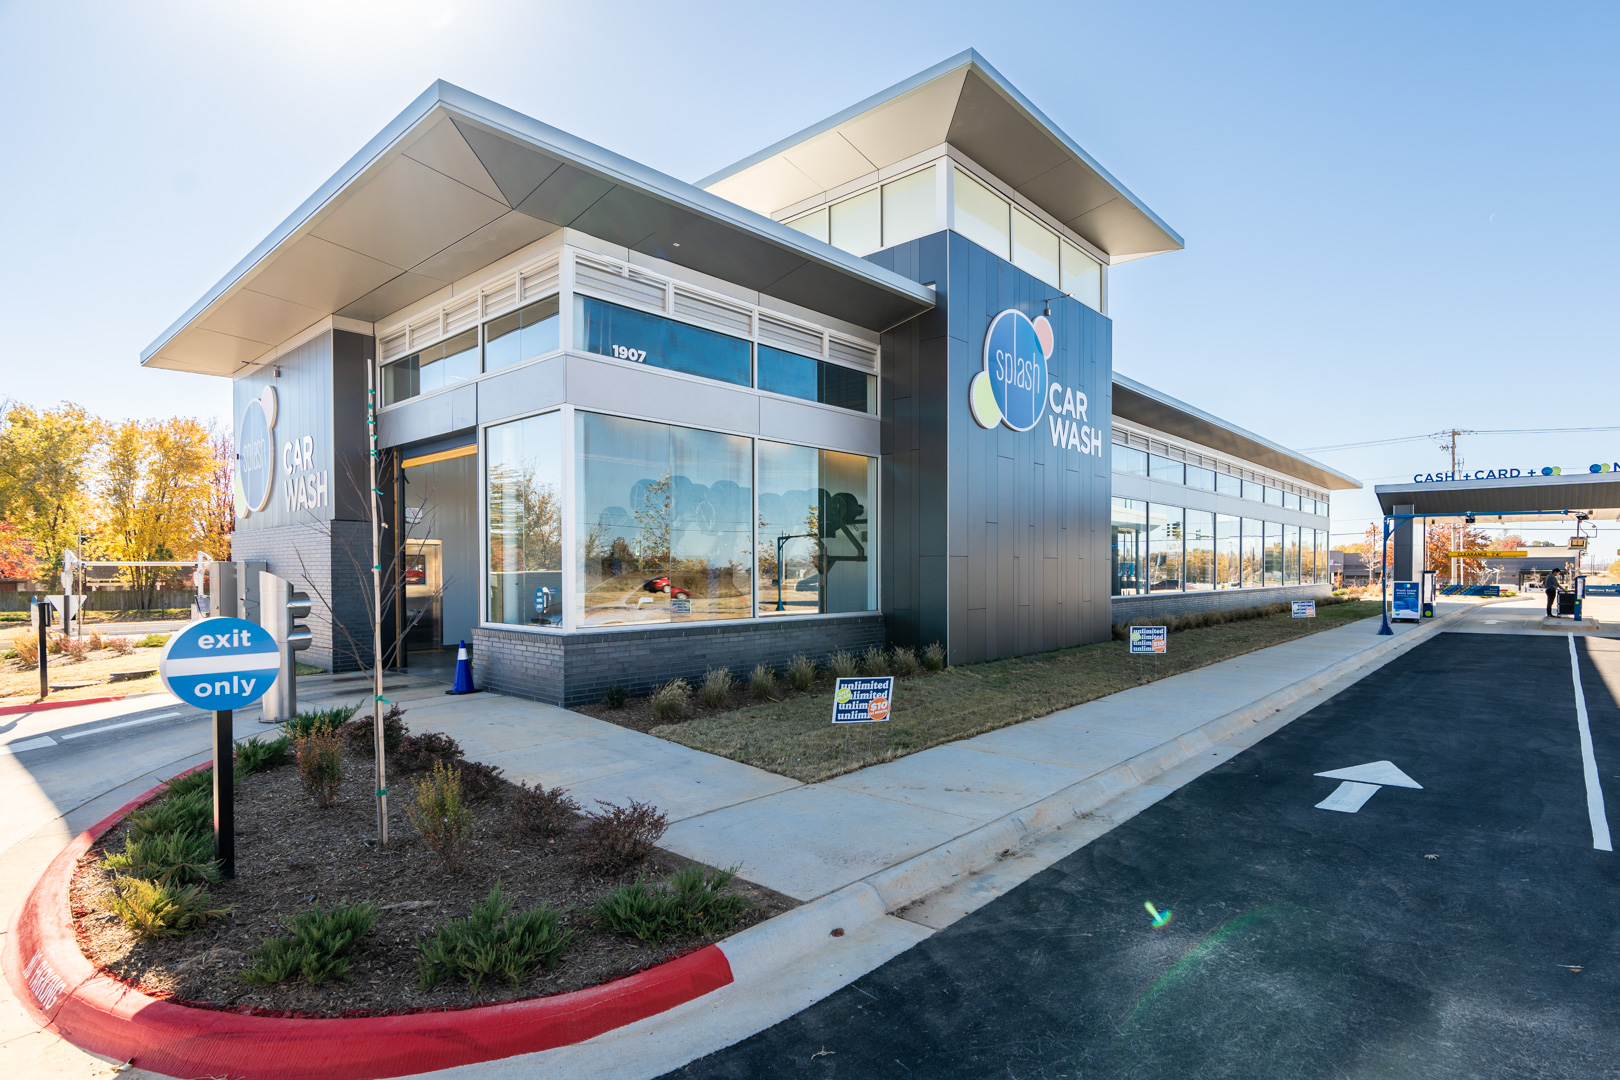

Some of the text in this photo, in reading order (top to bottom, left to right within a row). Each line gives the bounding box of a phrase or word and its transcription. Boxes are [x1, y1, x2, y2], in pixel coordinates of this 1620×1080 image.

[612, 344, 647, 363] 1907
[996, 348, 1041, 395] splash
[1049, 382, 1088, 422] CAR
[242, 429, 267, 473] splash
[1048, 415, 1102, 457] WASH
[283, 435, 314, 476] CAR
[1413, 472, 1455, 483] CASH
[1474, 468, 1520, 480] CARD
[284, 470, 328, 513] WASH
[197, 627, 252, 649] exit
[193, 677, 257, 698] only
[840, 680, 889, 690] unlimited
[838, 701, 869, 710] unlim
[870, 701, 888, 712] $10
[28, 960, 67, 1010] PARKING
